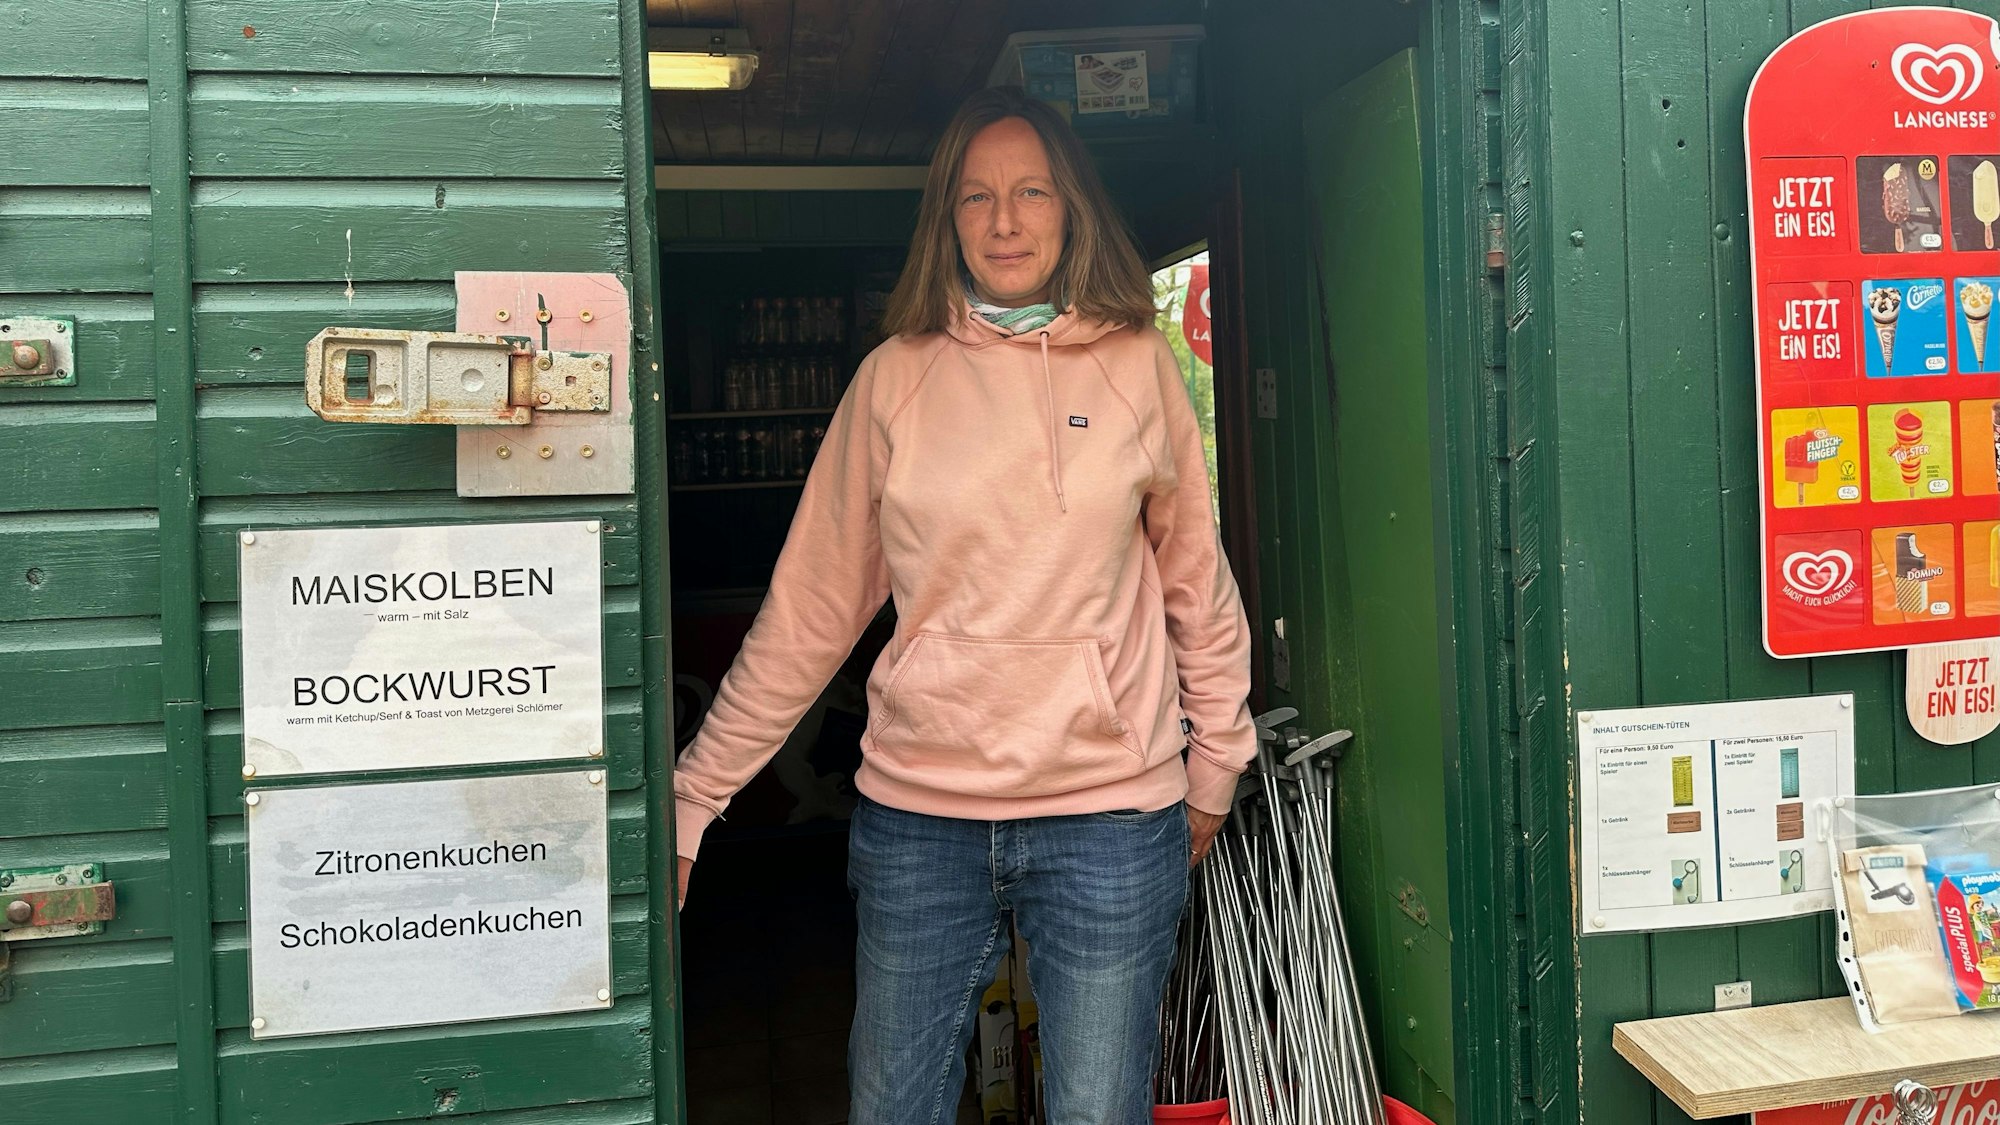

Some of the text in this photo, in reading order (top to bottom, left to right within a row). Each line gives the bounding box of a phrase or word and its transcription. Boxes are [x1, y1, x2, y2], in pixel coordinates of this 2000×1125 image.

[1773, 176, 1834, 209] JETZT
[1906, 285, 1943, 310] Cornetto
[1779, 299, 1840, 331] JETZT
[1806, 436, 1842, 452] FLUTSCH-
[1807, 446, 1837, 462] FINGER
[292, 567, 554, 605] MAISKOLBEN
[1907, 567, 1943, 580] DOMINO
[1782, 584, 1804, 603] MACHT
[1804, 597, 1822, 606] EUCH
[378, 612, 409, 622] warm
[423, 610, 441, 621] mit
[444, 609, 469, 621] Salz
[294, 665, 556, 706] BOCKWURST
[1935, 657, 1989, 688] JETZT
[286, 702, 563, 725] warm mit Ketchup/Senf & Toast von Metzgerei Schlömer
[1927, 685, 1995, 718] EIN EIS!
[1593, 721, 1690, 734] INHALT GUTSCHEIN-TÜTEN
[314, 840, 547, 875] Zitronenkuchen
[280, 906, 582, 949] Schokoladenkuchen
